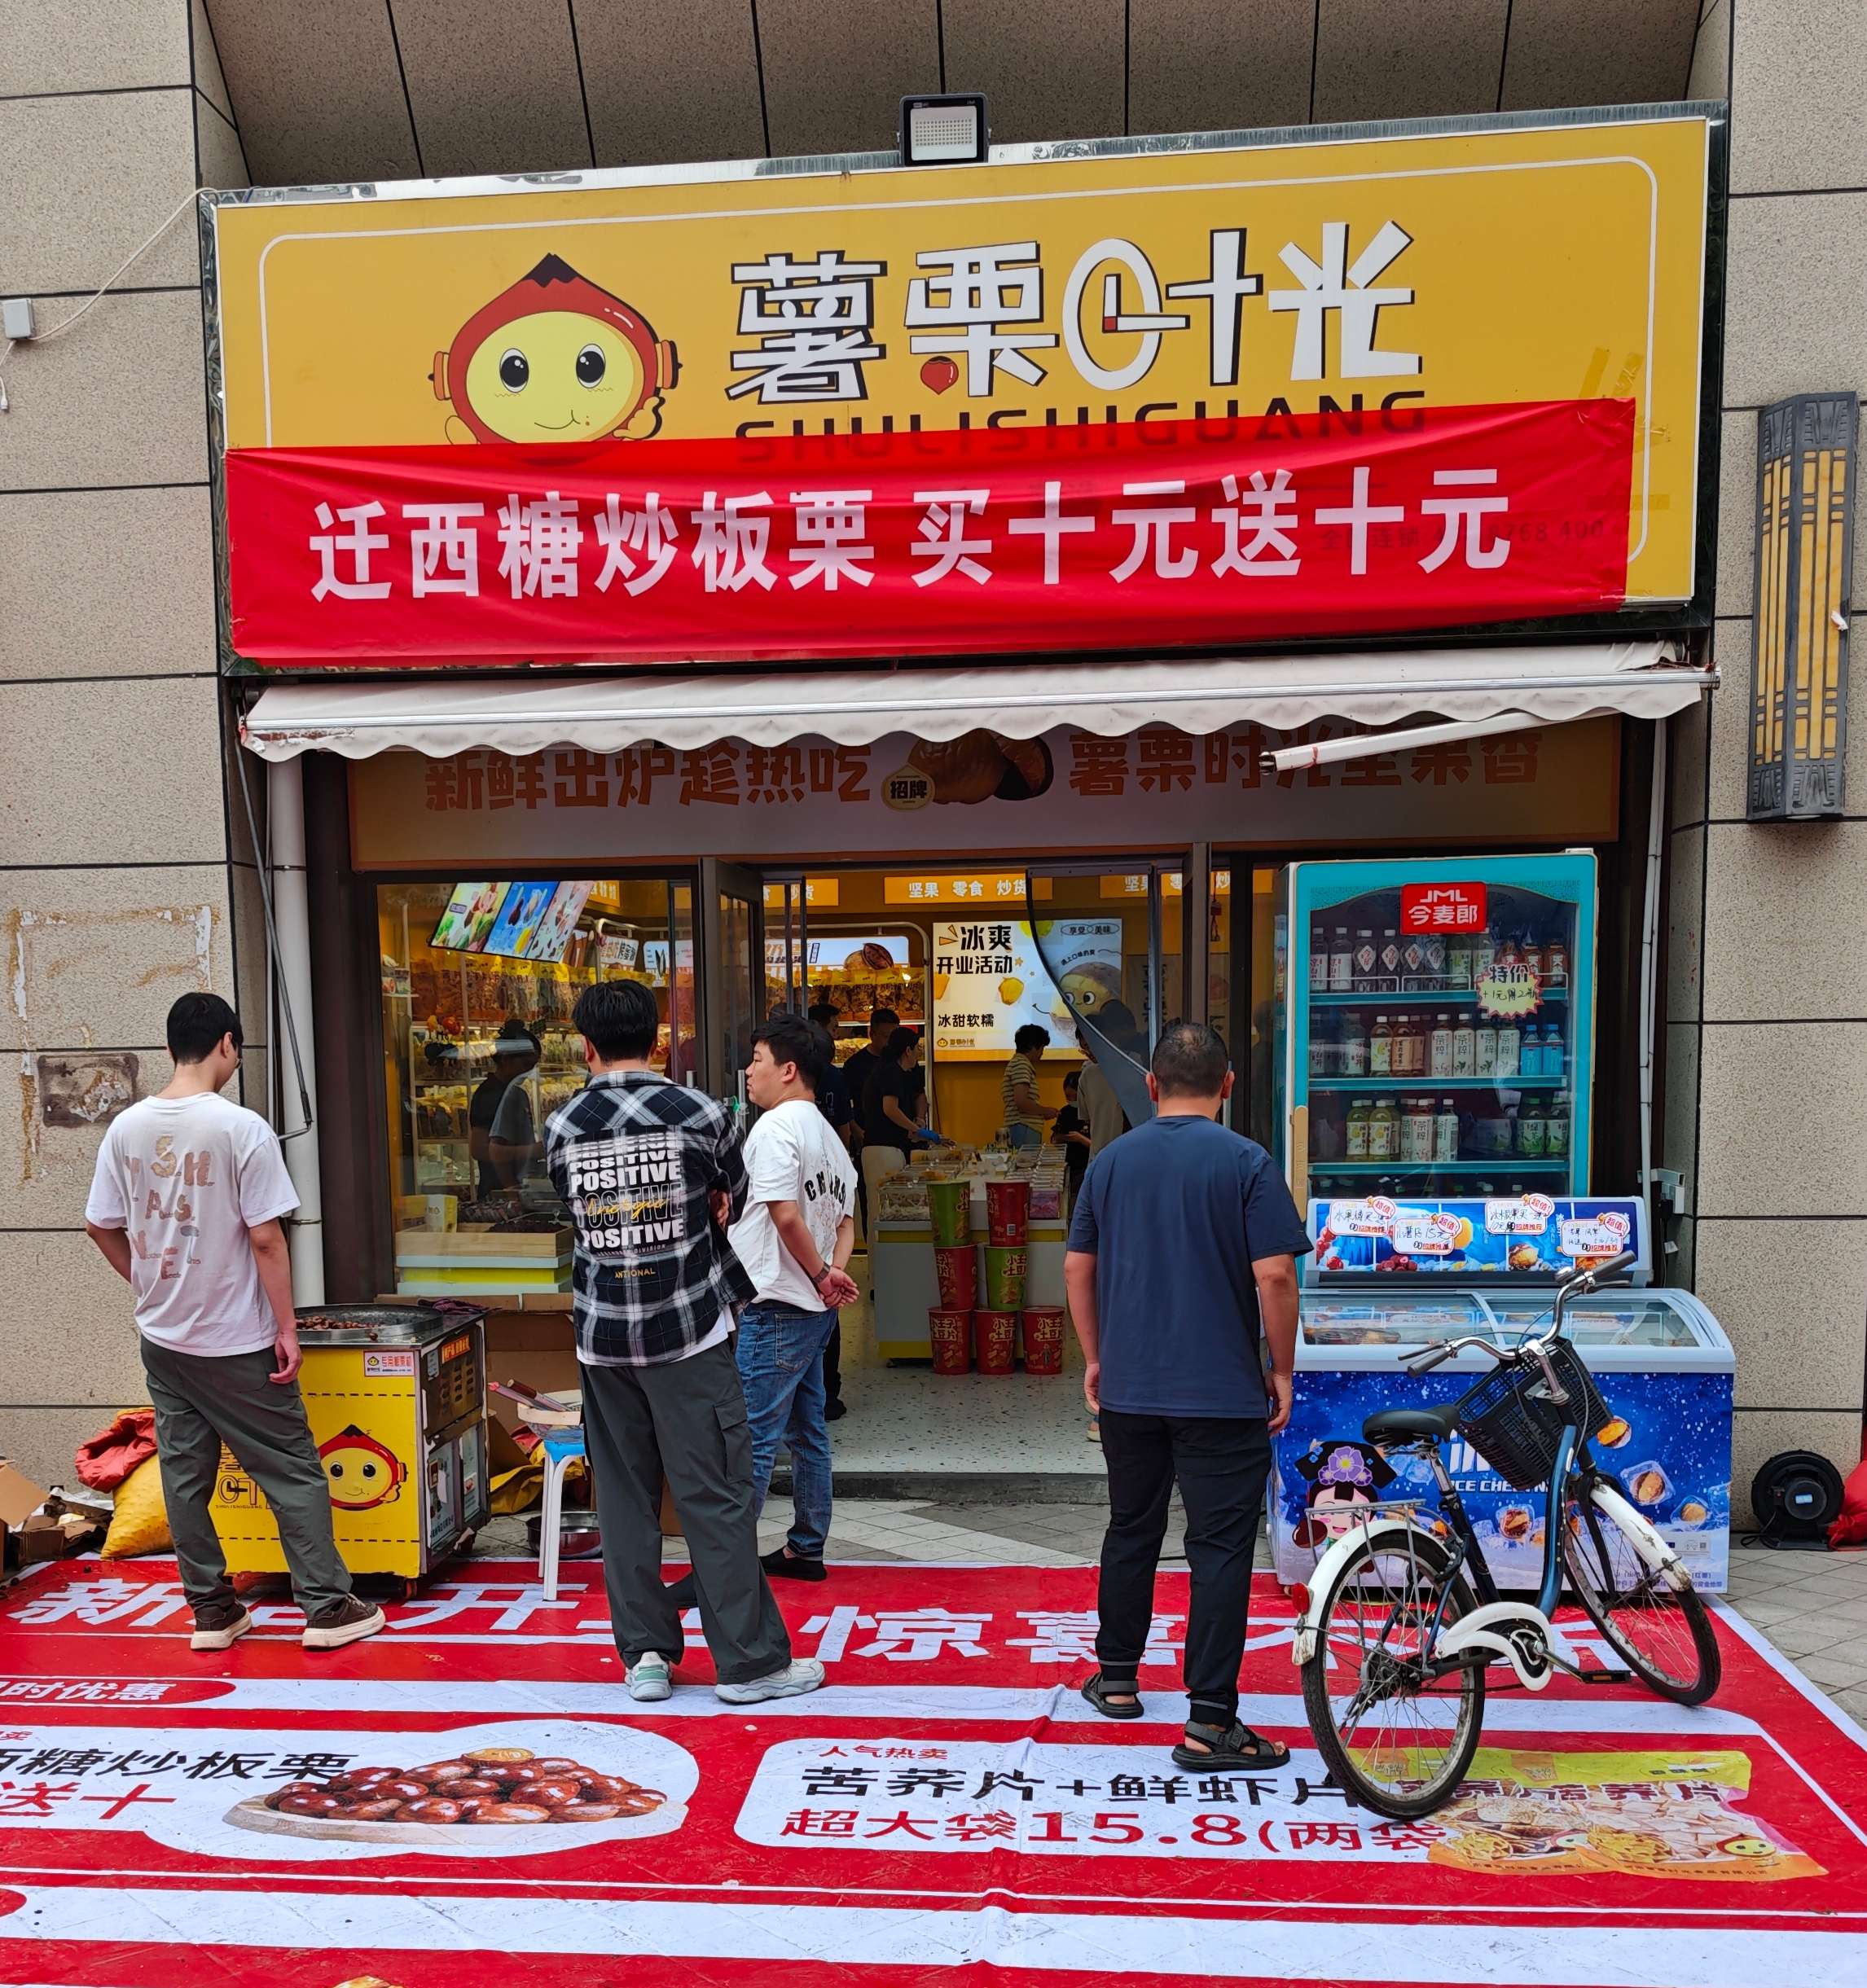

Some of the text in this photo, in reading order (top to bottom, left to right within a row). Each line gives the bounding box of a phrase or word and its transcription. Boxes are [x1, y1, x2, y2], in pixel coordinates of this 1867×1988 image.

[725, 221, 1422, 405] 薯栗时光
[310, 467, 1510, 603] 迁西糖炒板栗 买十元送十元
[425, 739, 872, 810] 新鲜出炉趁热吃
[890, 779, 928, 800] 招牌
[908, 880, 1027, 897] 坚果 零食 炒货
[1420, 889, 1468, 903] JML
[1408, 905, 1478, 925] 今麦郎
[960, 924, 1013, 952] 冰爽
[936, 955, 1013, 975] 开业活动
[1488, 964, 1529, 984] 特价
[938, 1013, 995, 1028] 冰甜软糯
[570, 1149, 680, 1173] POSITIVE
[571, 1161, 682, 1192] POSITIVE
[582, 1218, 684, 1249] POSITIVE
[819, 1744, 949, 1762] 人气热卖
